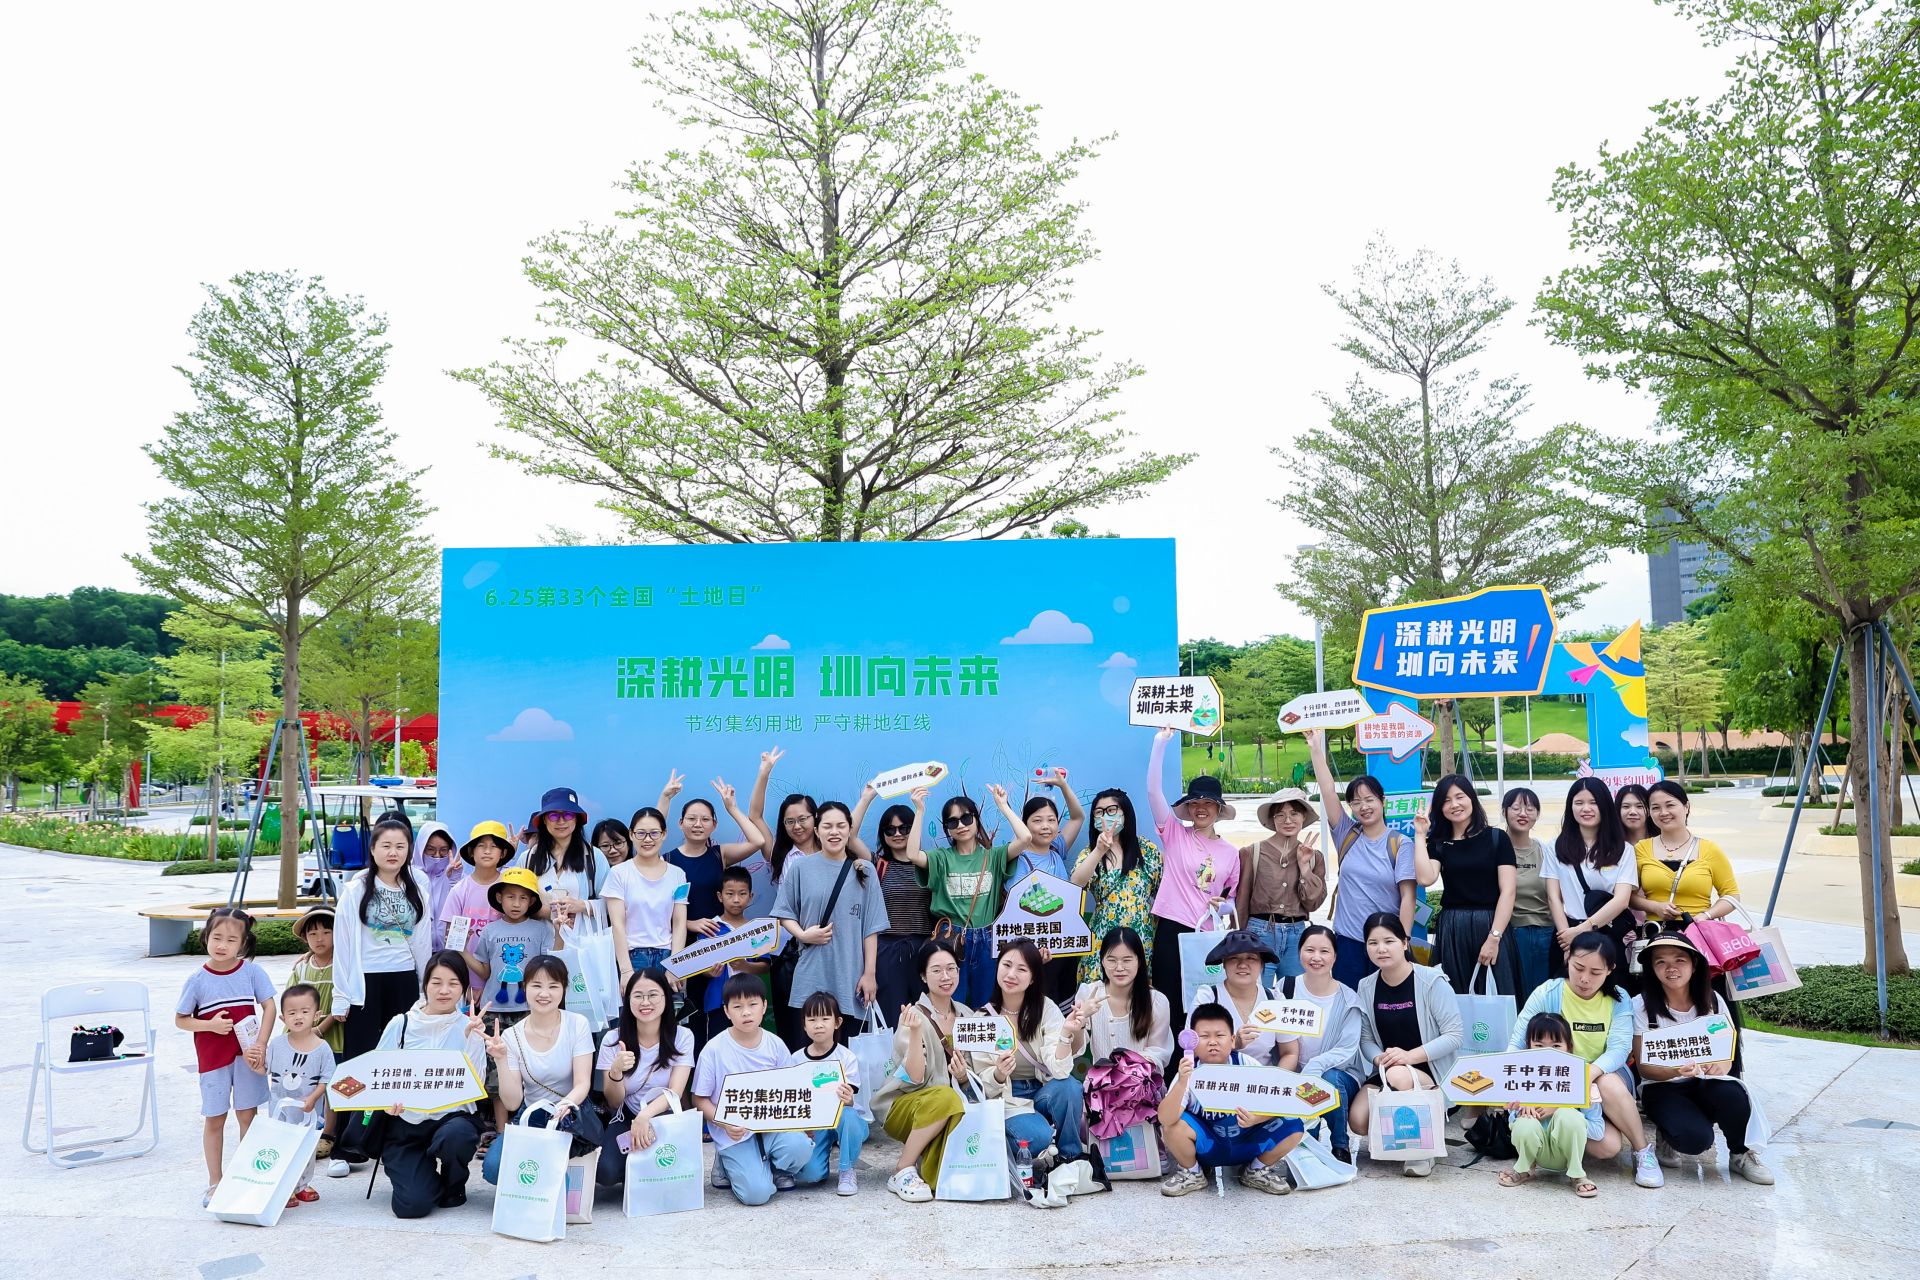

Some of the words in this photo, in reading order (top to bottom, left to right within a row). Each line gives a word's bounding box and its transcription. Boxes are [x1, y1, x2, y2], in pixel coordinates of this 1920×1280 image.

[1394, 618, 1517, 647] 深耕光明
[1395, 648, 1519, 677] 圳向未来
[616, 655, 795, 699] 深耕光明
[819, 654, 1000, 697] 圳向未来
[1137, 683, 1194, 699] 深耕土地
[1136, 699, 1193, 715] 圳向未来
[685, 714, 803, 733] 节约集约用地
[813, 713, 931, 733] 严守耕地红线
[996, 921, 1062, 937] 耕地是我国
[957, 1022, 996, 1032] 深耕土地
[957, 1033, 996, 1043] 圳向未来
[1644, 1034, 1711, 1051] 节约集约用地
[1646, 1046, 1712, 1062] 严守耕地红线
[371, 1067, 466, 1078] 十分珍惜、合理利用
[1502, 1064, 1571, 1077] 手中有粮
[370, 1080, 465, 1091] 土地和切实保护耕地
[1194, 1079, 1240, 1093] 深耕光明
[1246, 1084, 1292, 1097] 圳向未来
[1504, 1080, 1571, 1093] 心中不慌
[725, 1088, 812, 1104] 节约集约用地
[723, 1105, 812, 1120] 严守耕地红线
